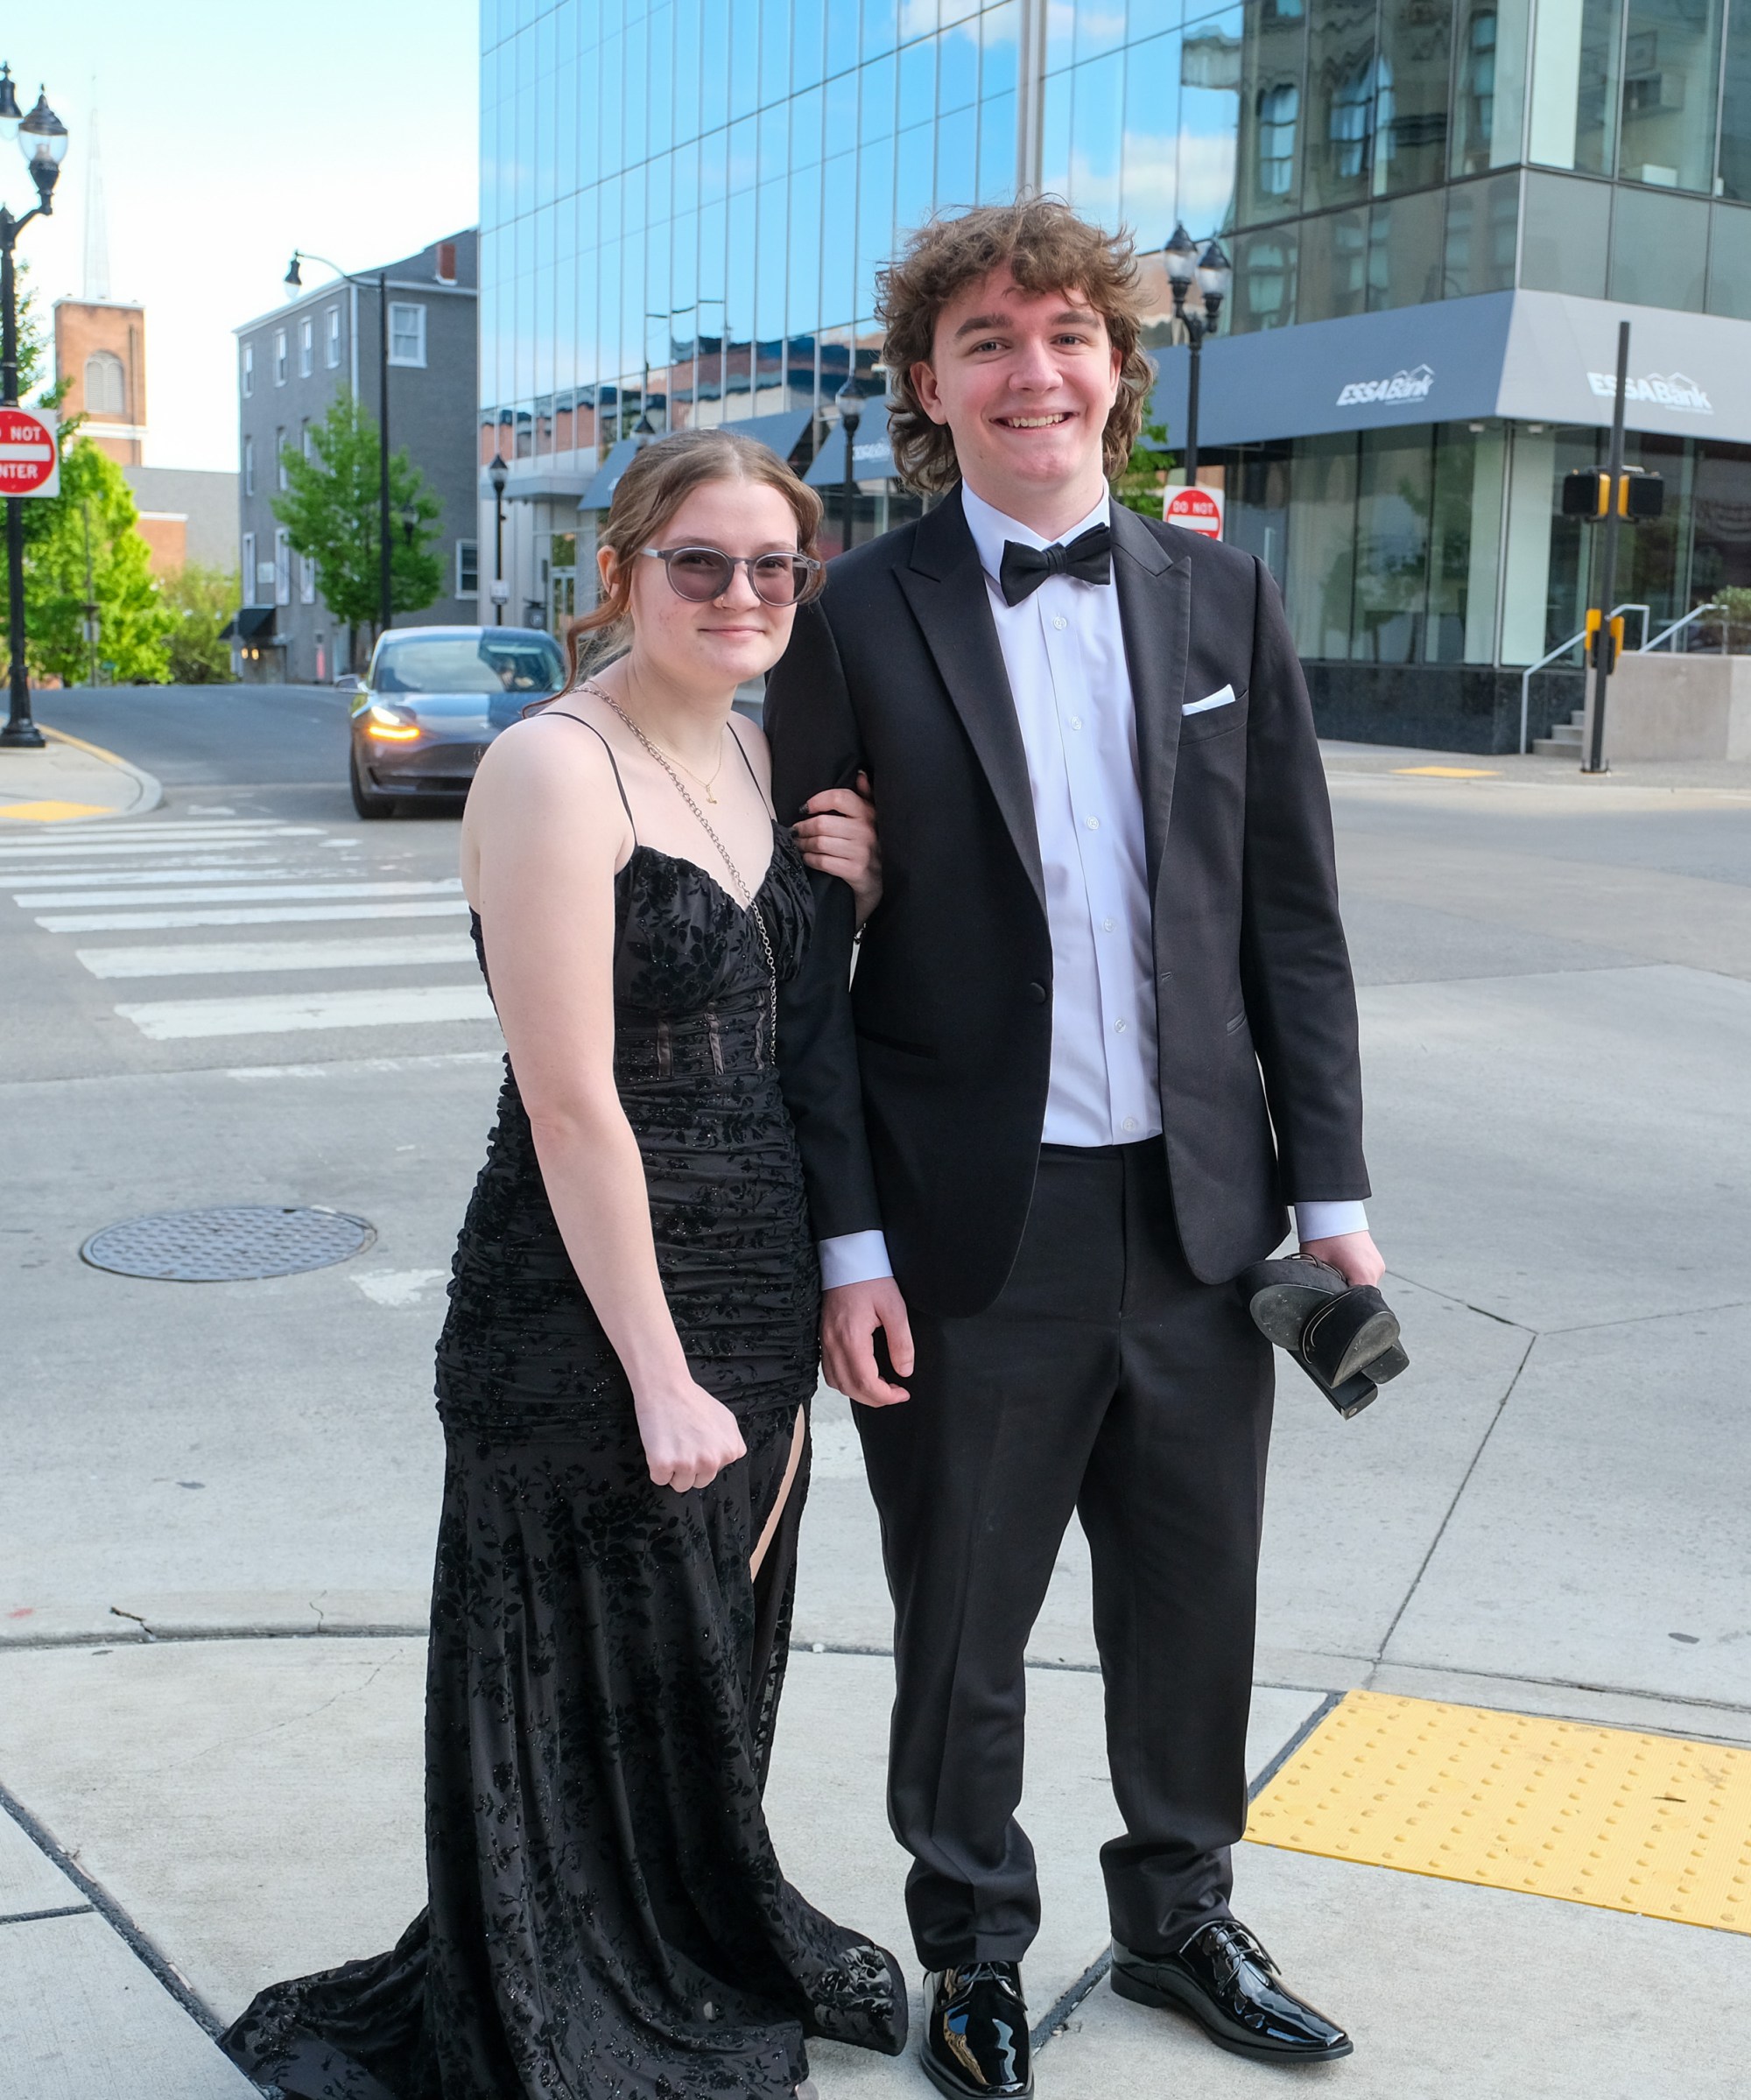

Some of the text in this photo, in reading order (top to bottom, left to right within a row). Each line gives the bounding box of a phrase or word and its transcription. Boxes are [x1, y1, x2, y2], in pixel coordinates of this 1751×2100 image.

[10, 426, 41, 441] NOT
[0, 464, 38, 479] NTER
[1173, 500, 1214, 516] DO NOT
